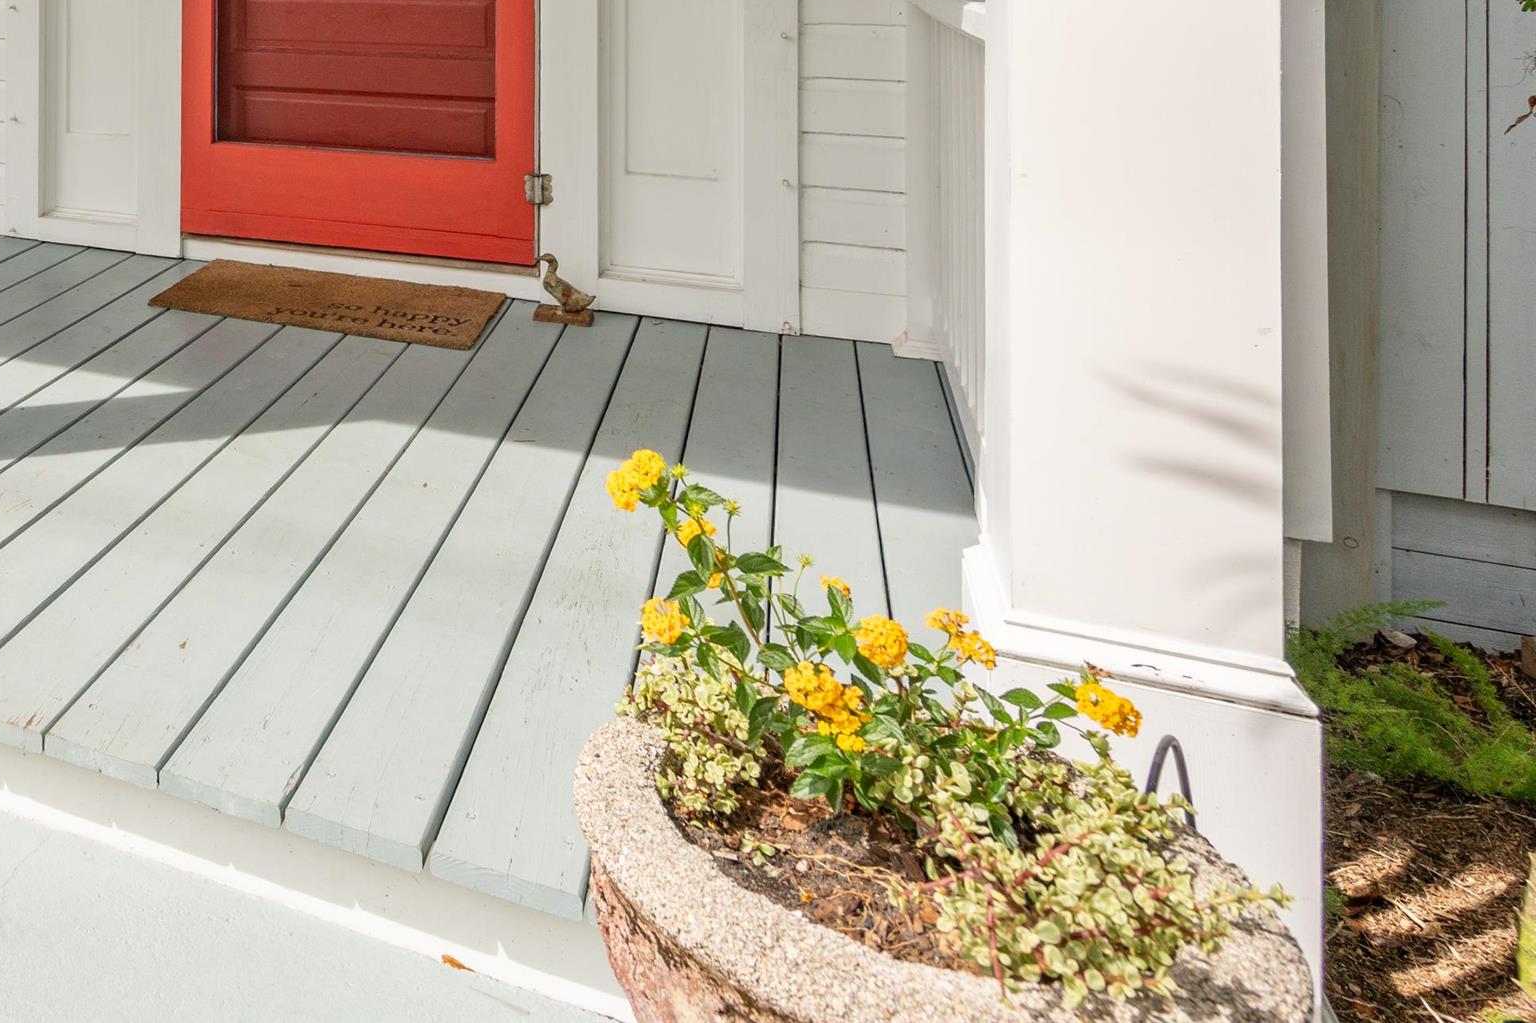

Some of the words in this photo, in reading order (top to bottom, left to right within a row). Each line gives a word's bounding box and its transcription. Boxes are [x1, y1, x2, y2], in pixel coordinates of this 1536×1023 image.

[266, 307, 369, 325] you're
[327, 302, 363, 311] so
[369, 304, 473, 327] happy
